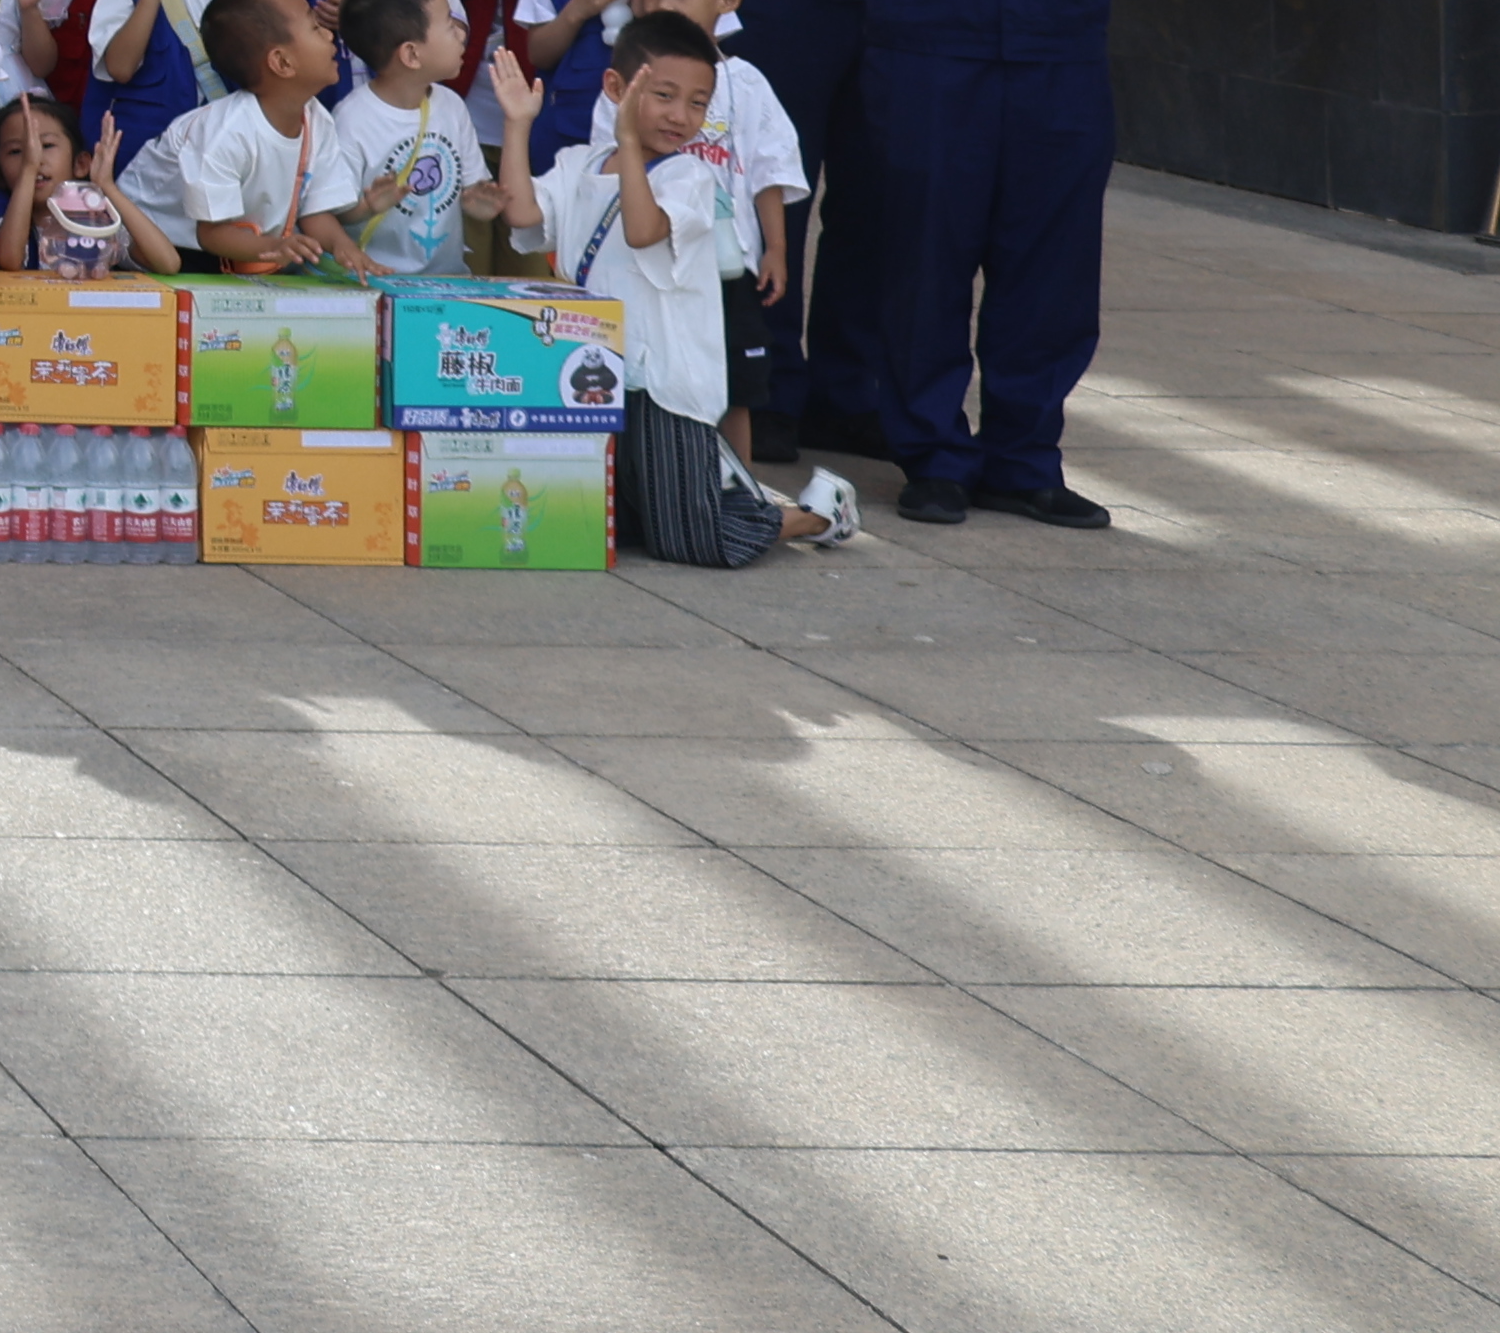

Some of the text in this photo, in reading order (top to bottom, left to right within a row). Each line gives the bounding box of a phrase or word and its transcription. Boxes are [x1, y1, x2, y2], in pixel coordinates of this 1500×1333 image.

[52, 330, 92, 356] 康师傅
[455, 327, 490, 348] 康师傅
[33, 359, 117, 386] 茉莉蜜茶
[439, 351, 496, 376] 藤椒
[475, 377, 522, 394] 牛肉面
[531, 414, 617, 424] 中国航天事业合作伙伴
[284, 471, 324, 495] 康师傅
[125, 517, 156, 527] 农夫山泉
[163, 516, 192, 526] 农夫山泉
[265, 500, 348, 527] 茉莉蜜茶
